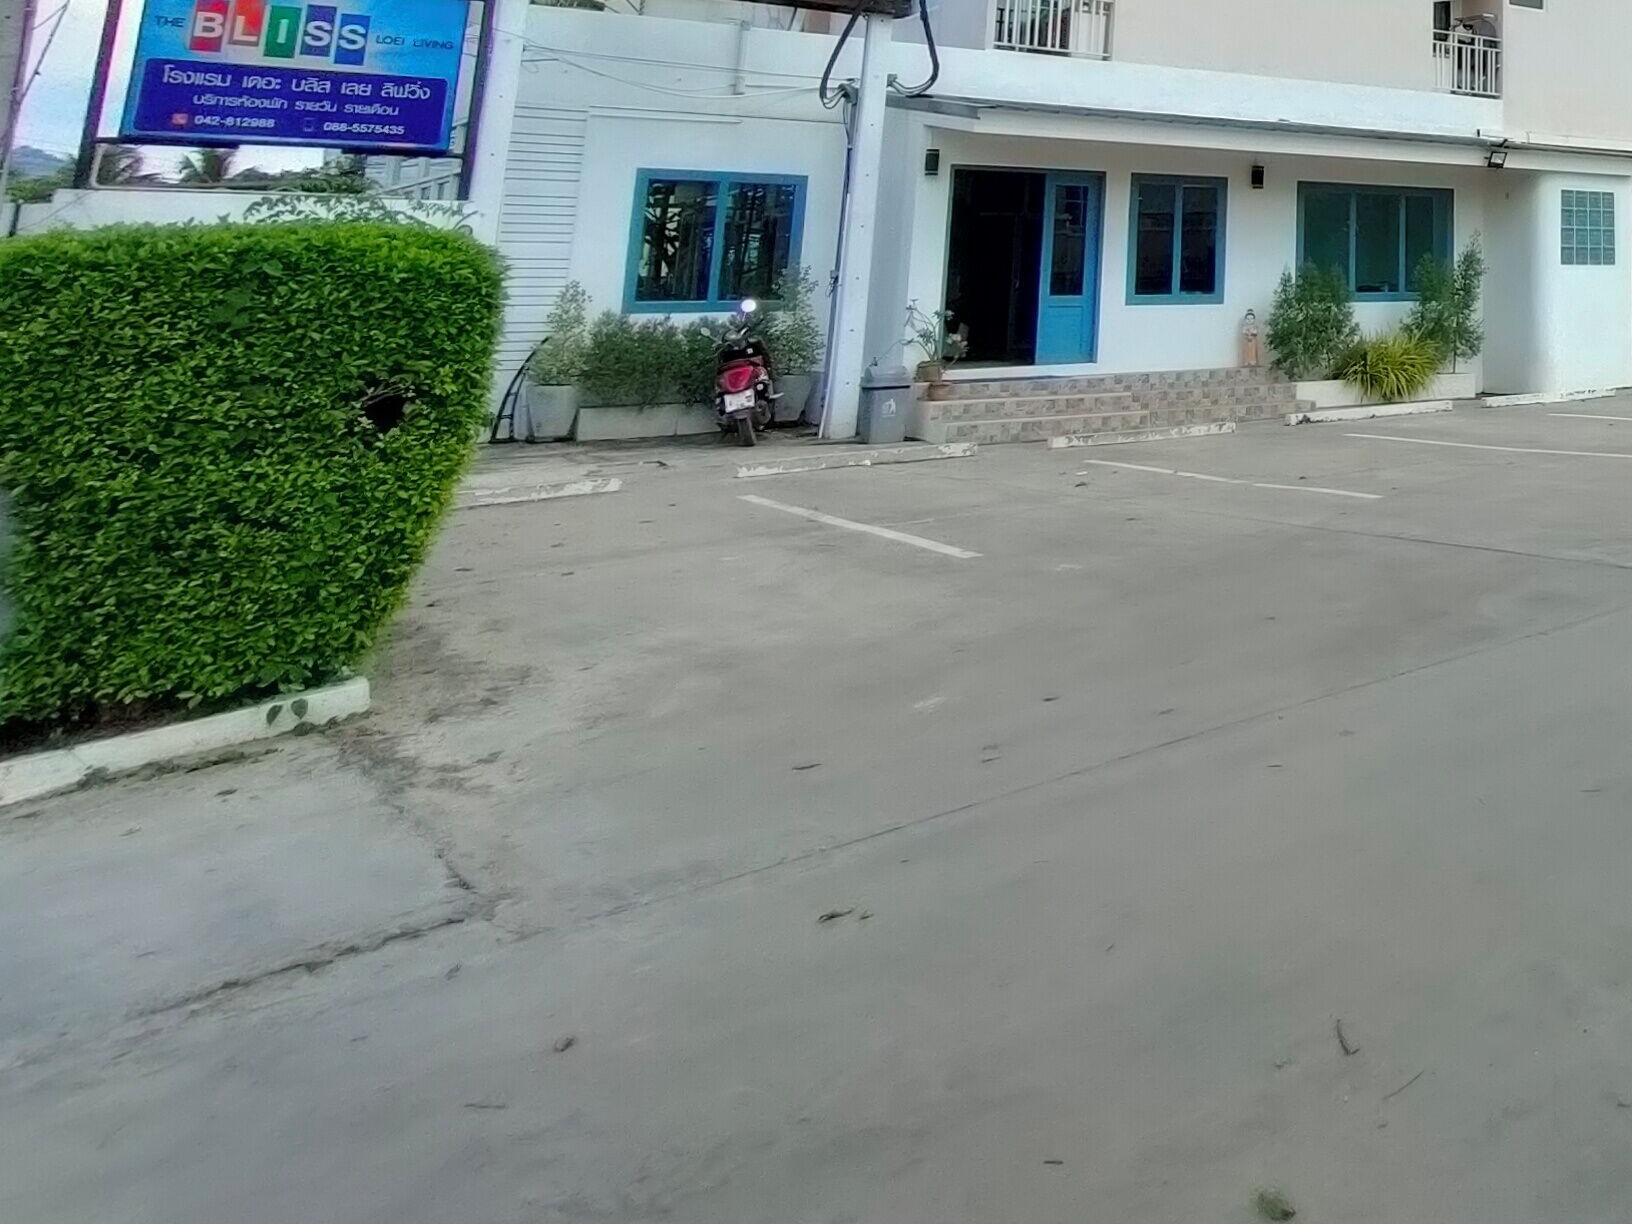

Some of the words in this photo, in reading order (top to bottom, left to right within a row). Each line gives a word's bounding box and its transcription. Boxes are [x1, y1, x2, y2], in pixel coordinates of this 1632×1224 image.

[154, 15, 186, 27] THE
[193, 11, 367, 51] BLISS
[376, 34, 405, 46] LOEI
[413, 38, 455, 50] LIVING
[162, 64, 232, 87] โรงแรม
[242, 75, 282, 90] เดอะ
[291, 77, 332, 94] บลิส
[340, 81, 372, 97] เลย
[381, 80, 431, 100] ลิฟวิ่ง
[192, 93, 288, 110] บริการห้องพัก
[294, 99, 338, 113] รายวัน
[343, 102, 400, 116] รายเดือน
